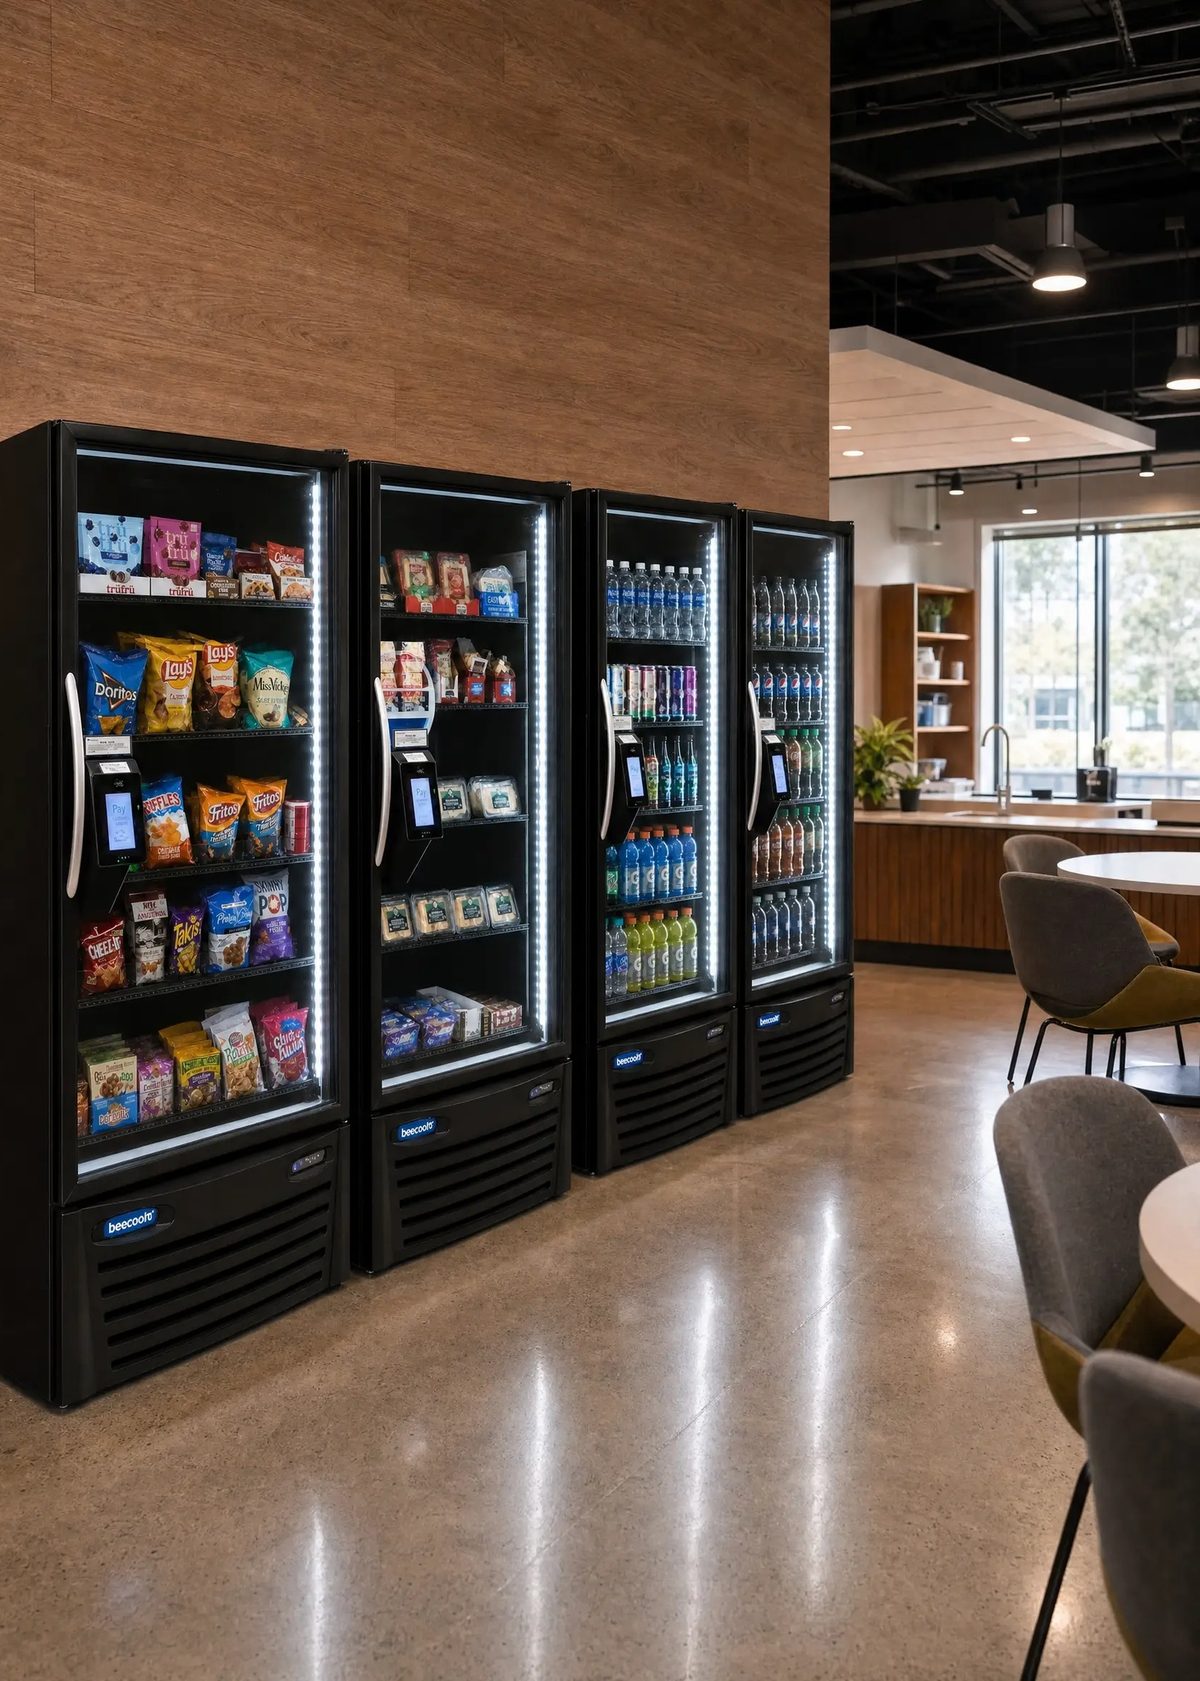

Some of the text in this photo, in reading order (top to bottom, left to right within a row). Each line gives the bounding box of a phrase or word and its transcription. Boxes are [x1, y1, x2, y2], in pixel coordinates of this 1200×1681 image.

[106, 584, 135, 594] trüfrü
[169, 587, 194, 597] trüfrü
[206, 644, 235, 664] Lay's
[164, 659, 193, 680] Lay's
[95, 682, 138, 702] Doritos
[112, 803, 126, 815] Pay
[252, 791, 281, 812] Fritos
[208, 802, 240, 823] Fritos
[255, 879, 284, 893] SKINNY
[258, 893, 287, 916] POP
[173, 920, 200, 950] Takis
